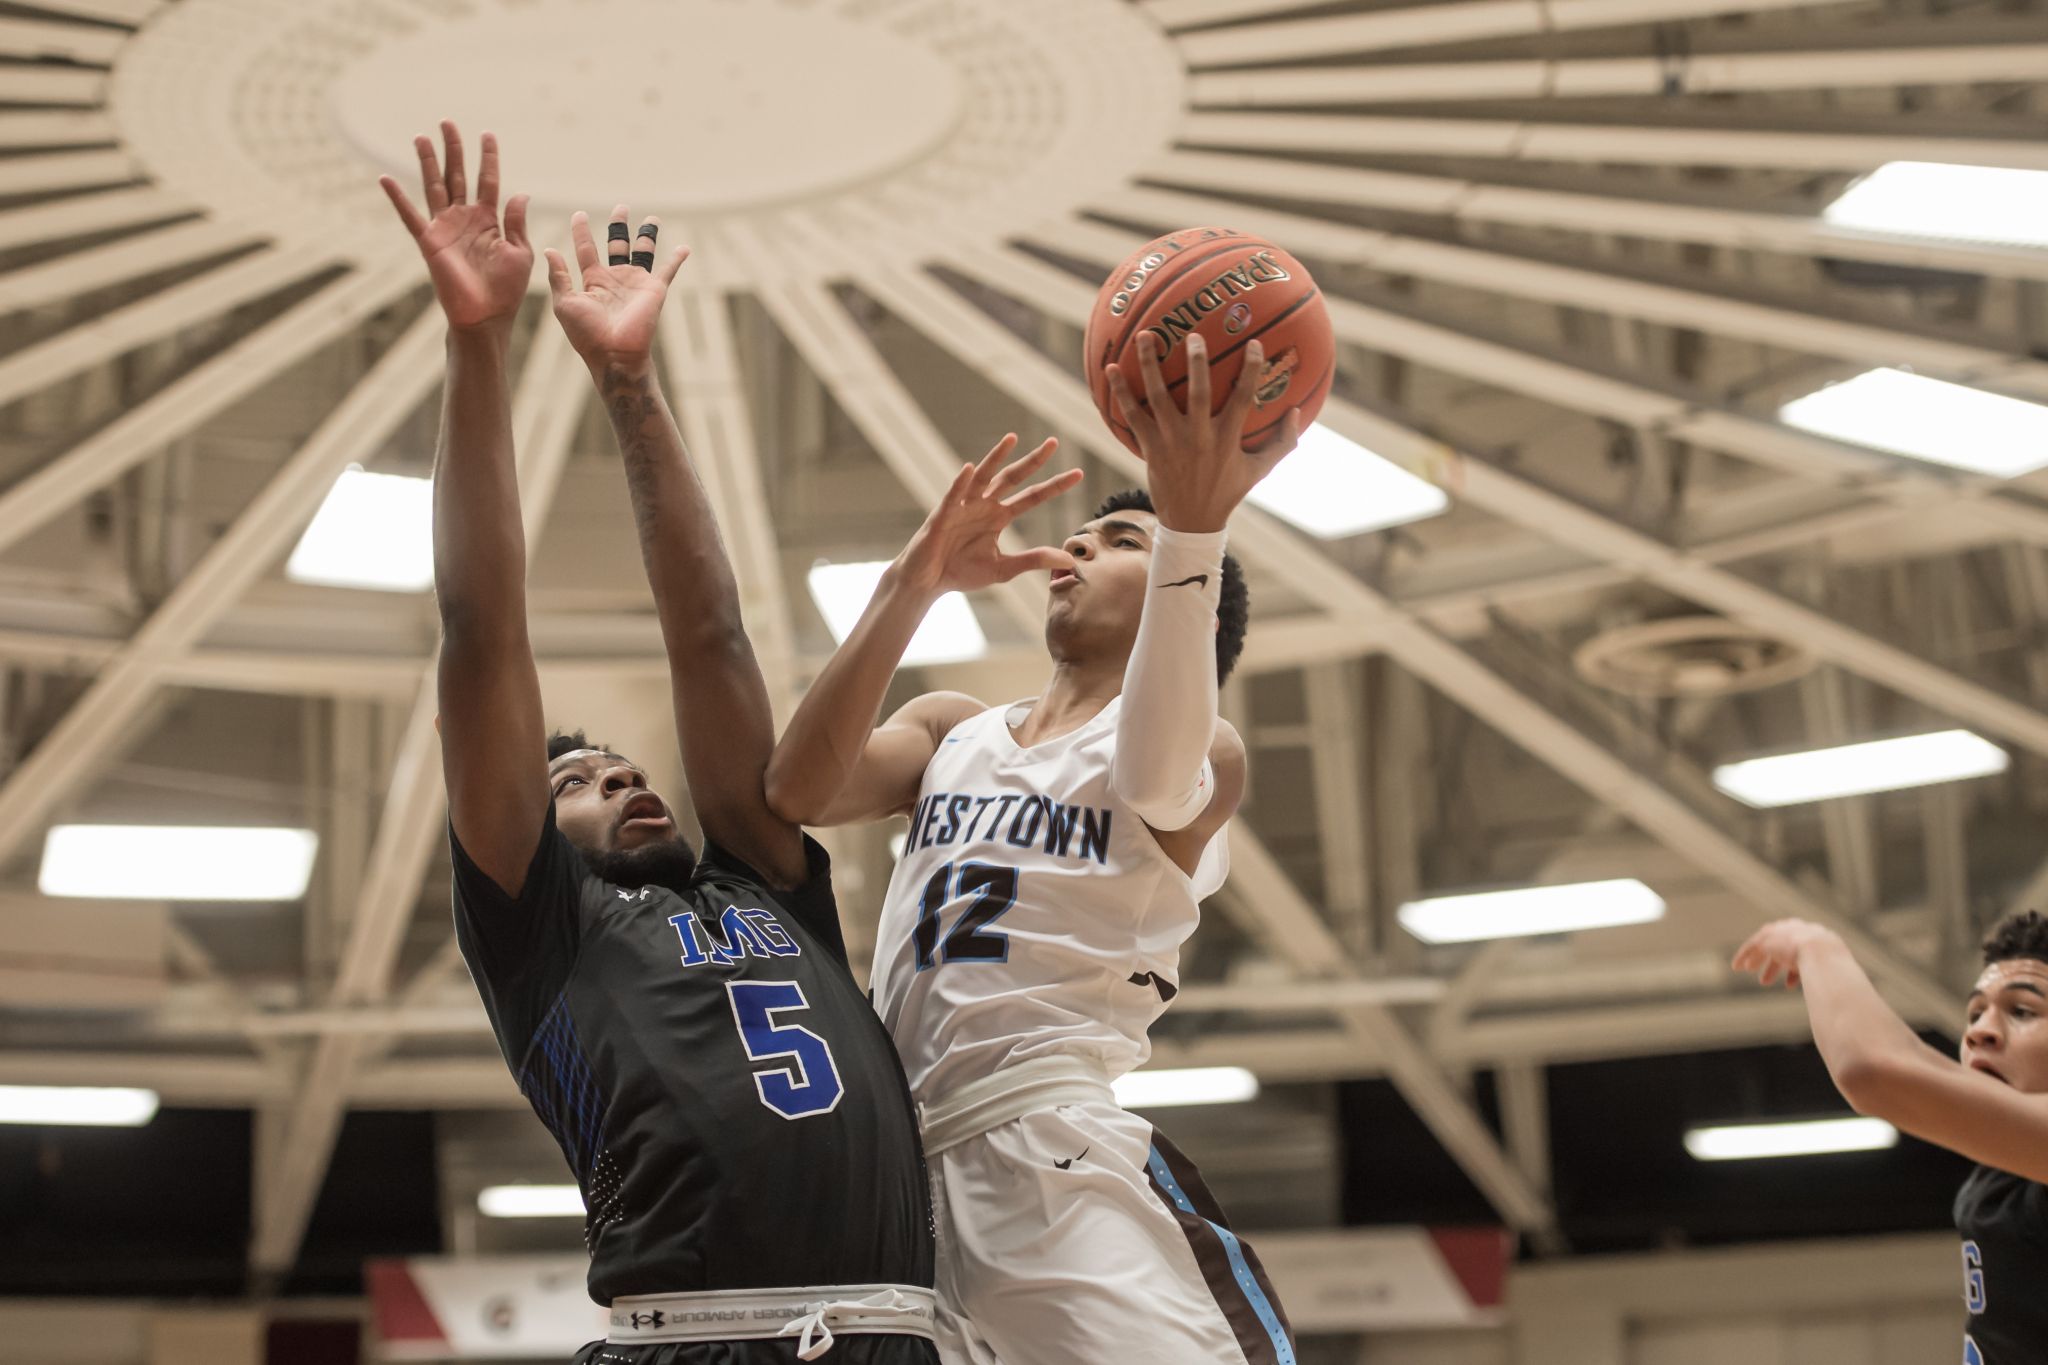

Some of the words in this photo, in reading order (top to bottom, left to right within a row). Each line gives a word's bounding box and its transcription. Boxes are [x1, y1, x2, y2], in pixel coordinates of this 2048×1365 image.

[667, 904, 801, 967] IMG
[912, 861, 1019, 972] 12
[725, 980, 845, 1120] 5
[672, 1310, 746, 1324] ARMOUR
